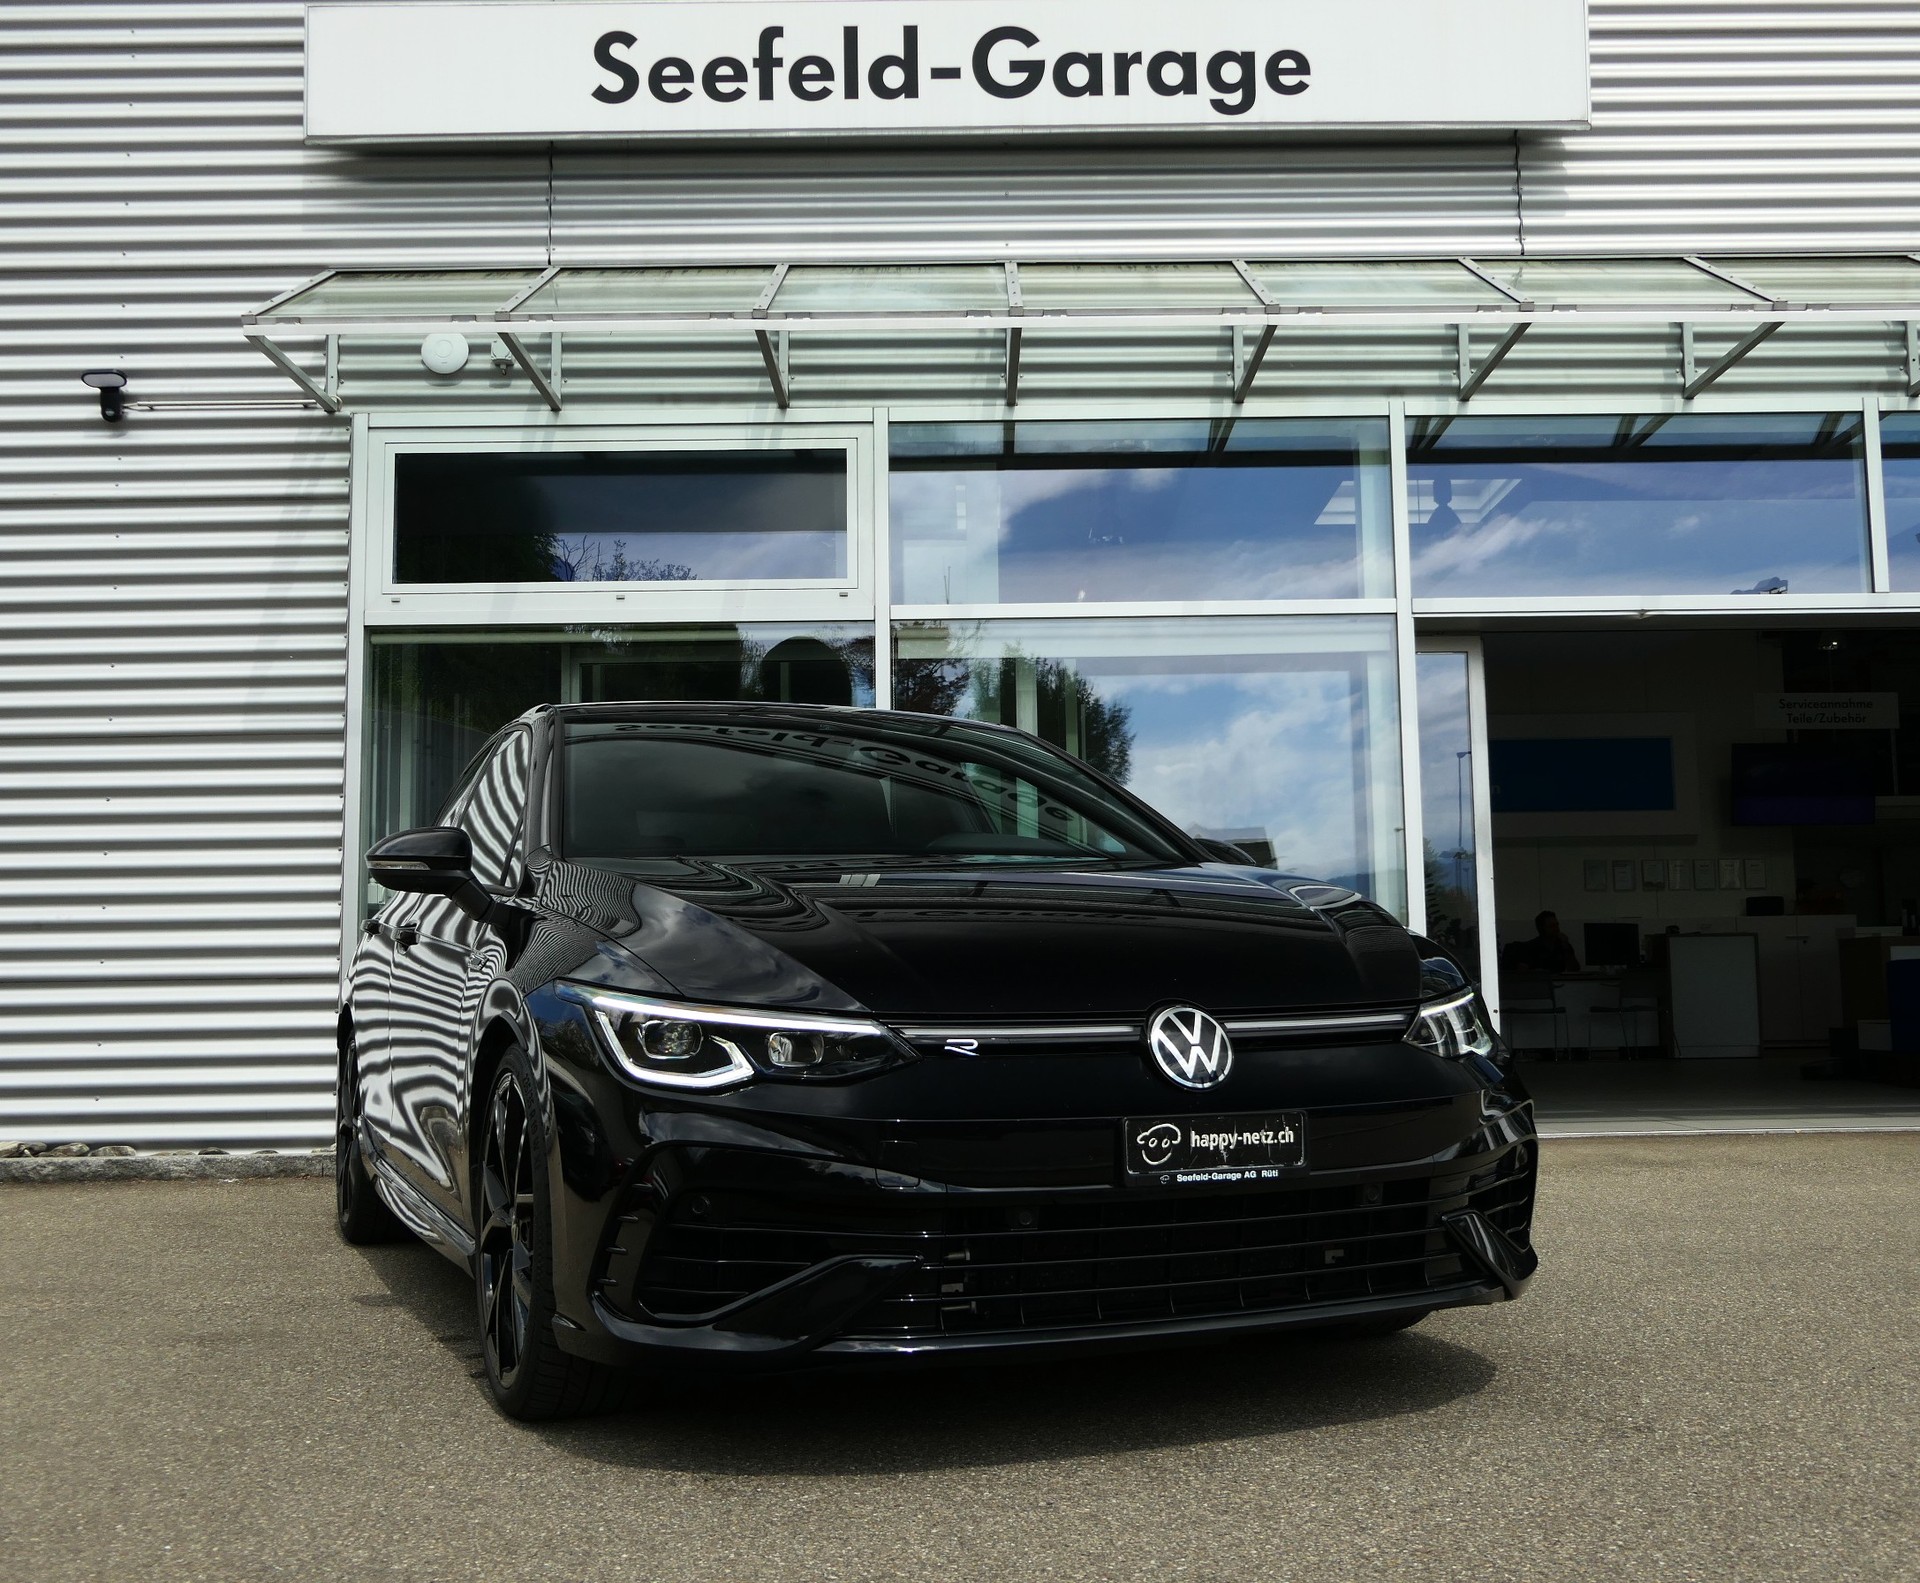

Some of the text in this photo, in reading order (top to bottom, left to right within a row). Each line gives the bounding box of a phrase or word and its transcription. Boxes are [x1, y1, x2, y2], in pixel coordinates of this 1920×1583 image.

[591, 25, 1311, 115] Seefeld-Garage
[1778, 698, 1873, 709] Serviceannahme
[1786, 712, 1866, 724] Teile/Zubehör
[1191, 1127, 1294, 1150] happy-netz.ch
[1177, 1169, 1279, 1182] Seefeld-Garage AG Rüti
